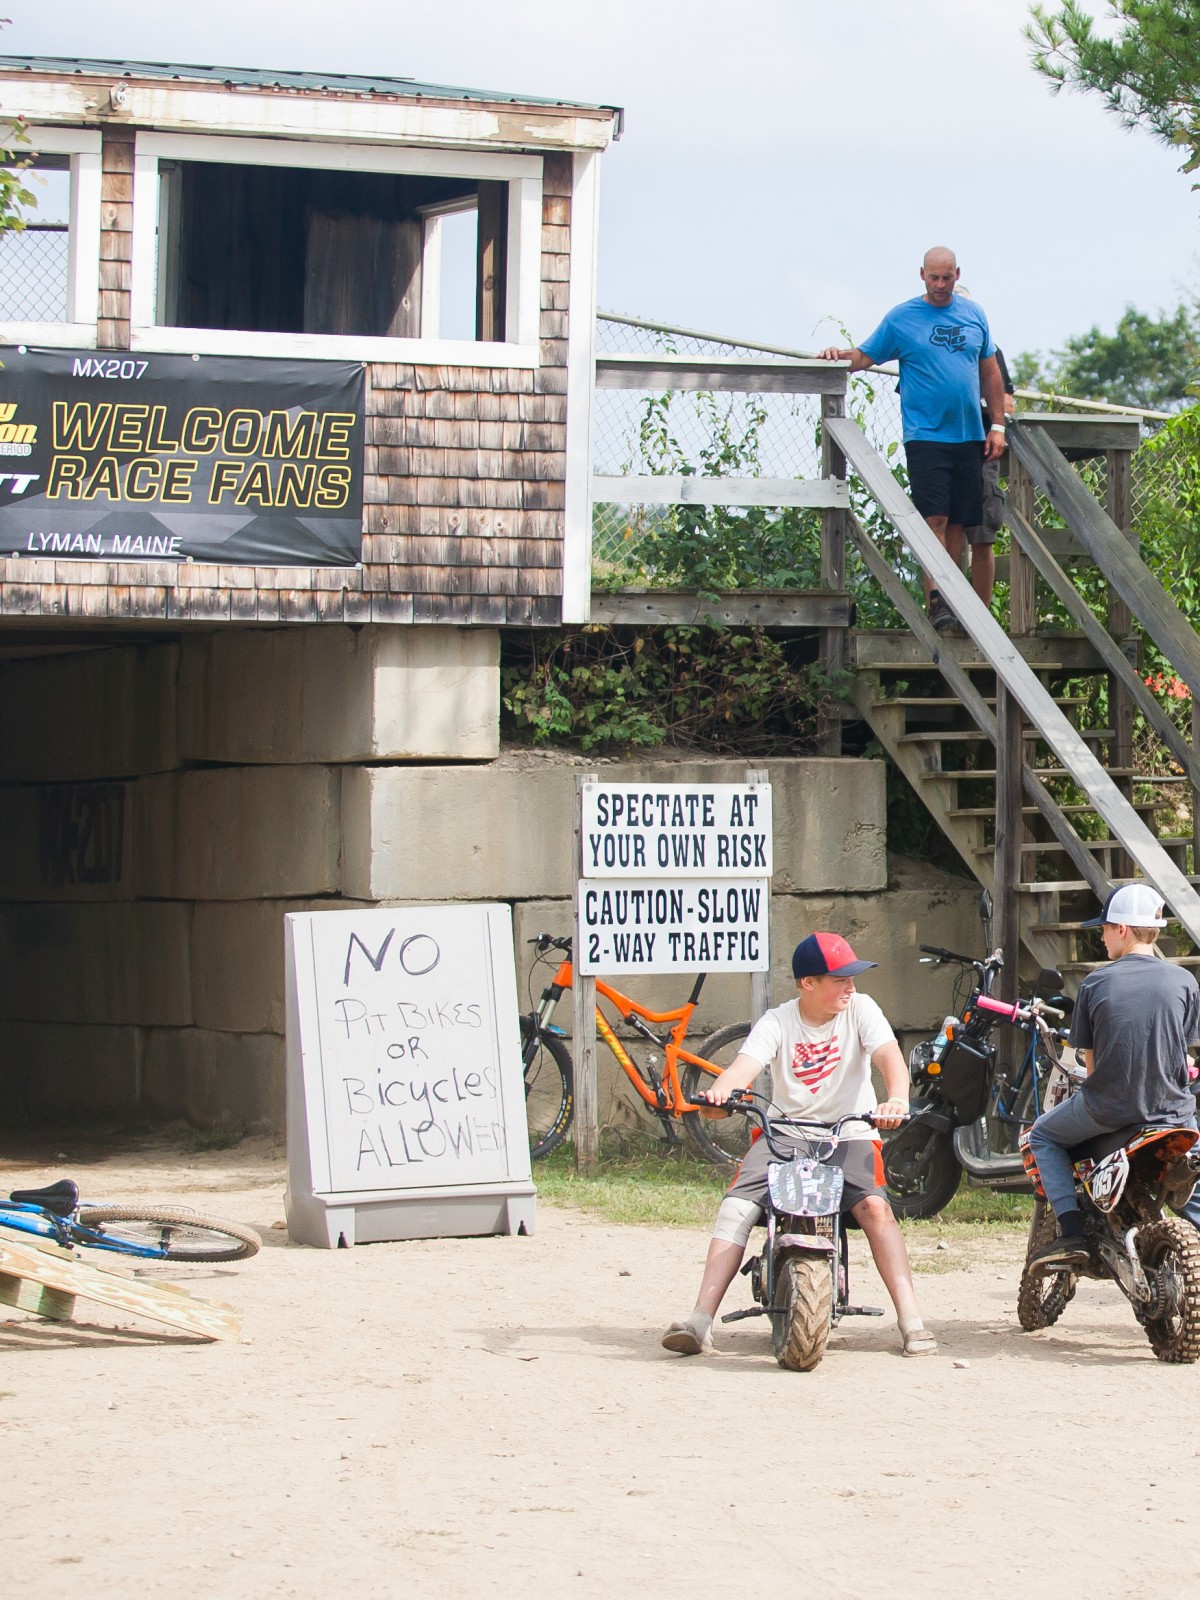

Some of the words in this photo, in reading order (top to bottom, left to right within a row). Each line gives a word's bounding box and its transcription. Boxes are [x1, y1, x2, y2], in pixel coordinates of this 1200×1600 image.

[72, 357, 149, 380] MX207
[52, 401, 356, 460] WELCOME
[46, 455, 199, 503] RACE
[208, 461, 352, 509] FANS
[27, 532, 105, 556] LYMAN,
[112, 535, 183, 555] MAINE
[597, 793, 715, 827] SPECTATE
[730, 794, 758, 827] AT
[589, 834, 646, 867] YOUR
[657, 834, 706, 867] OWN
[717, 834, 767, 867] RISK
[343, 928, 440, 986] NO
[588, 932, 656, 963] 2-WAY
[668, 930, 759, 962] TRAFFIC
[387, 1036, 429, 1060] OR
